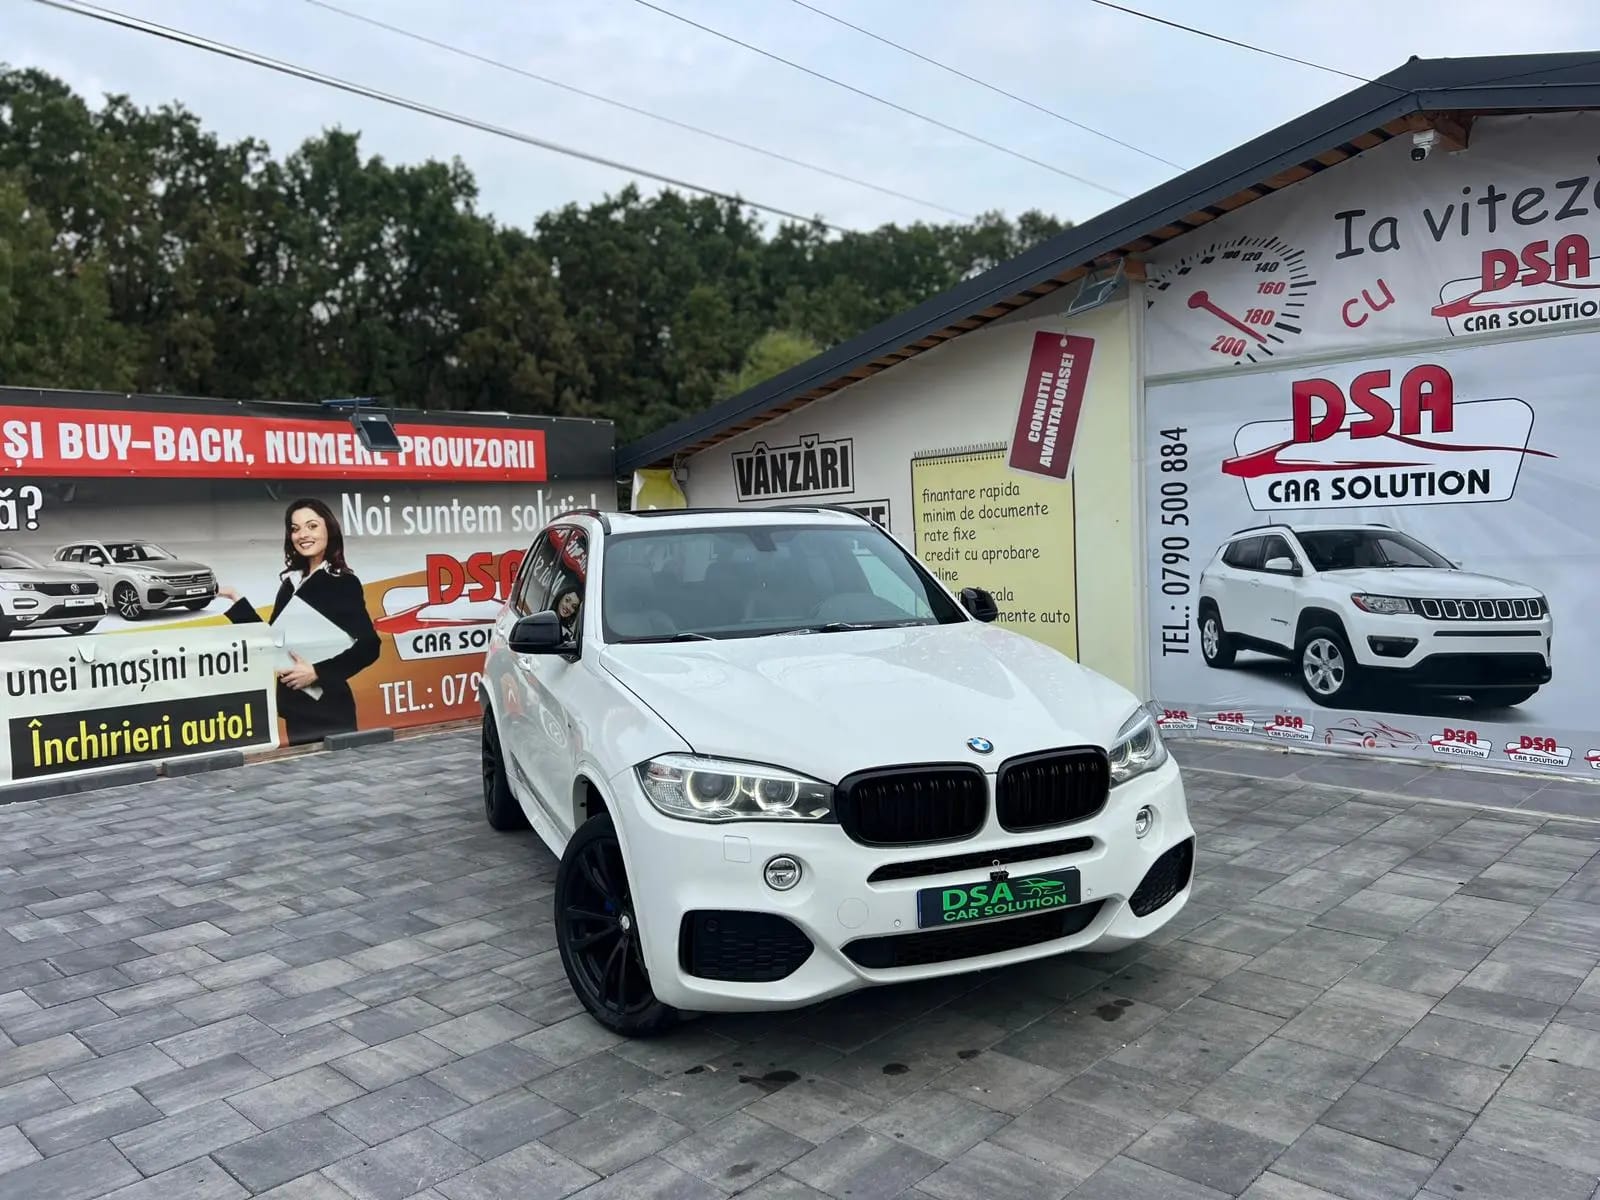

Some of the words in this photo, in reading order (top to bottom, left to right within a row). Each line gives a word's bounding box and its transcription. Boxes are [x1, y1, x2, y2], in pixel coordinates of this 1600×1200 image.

[1334, 208, 1401, 260] Ia
[1423, 170, 1600, 242] vitez
[1241, 251, 1263, 262] 120
[1255, 261, 1280, 273] 140
[1482, 234, 1590, 293] DSA
[1257, 281, 1286, 295] 160
[1342, 278, 1396, 328] cu
[1243, 308, 1275, 326] 180
[1464, 315, 1501, 332] CAR
[1508, 301, 1600, 328] SOLUTIO
[1210, 335, 1247, 357] 200
[1028, 371, 1054, 443] CONDITII
[1040, 353, 1075, 468] AVANTAJOASE!
[1292, 364, 1453, 443] DSA
[397, 436, 535, 469] PROVIZORII
[1160, 427, 1188, 472] 884
[736, 441, 850, 496] VÂNZĂRI
[922, 488, 976, 503] finantare
[980, 481, 1020, 502] rapida
[1268, 479, 1320, 503] CAR
[1332, 469, 1490, 500] SOLUTION
[0, 486, 43, 530] ă?
[341, 493, 391, 536] Noi
[402, 499, 502, 535] suntem
[923, 508, 956, 523] minim
[960, 505, 975, 521] de
[978, 502, 1049, 520] documente
[1161, 482, 1190, 526] 500
[924, 529, 949, 542] rate
[953, 526, 977, 542] fixe
[924, 548, 961, 562] credit
[964, 550, 978, 561] cu
[981, 545, 1040, 564] aprobare
[1161, 536, 1190, 595] 0790
[996, 609, 1037, 623] mente
[1040, 609, 1070, 624] auto
[1162, 605, 1190, 656] TEL.:
[412, 632, 451, 653] CAR
[7, 656, 77, 697] unei
[90, 646, 187, 692] mașini
[199, 640, 249, 677] noi!
[379, 680, 434, 715] TEL.:
[441, 672, 482, 706] 079
[28, 718, 172, 767] Închirieri
[182, 703, 253, 746] auto!
[1275, 714, 1303, 729] DSA
[1281, 731, 1309, 739] SOLUTION
[1443, 728, 1478, 744] DSA
[1452, 747, 1485, 757] SOLUTION
[1520, 736, 1557, 752] DSA
[1528, 756, 1564, 765] SOLUTION
[943, 882, 1014, 911] DSA
[943, 909, 979, 922] CAR
[984, 894, 1067, 915] SOLUTION
